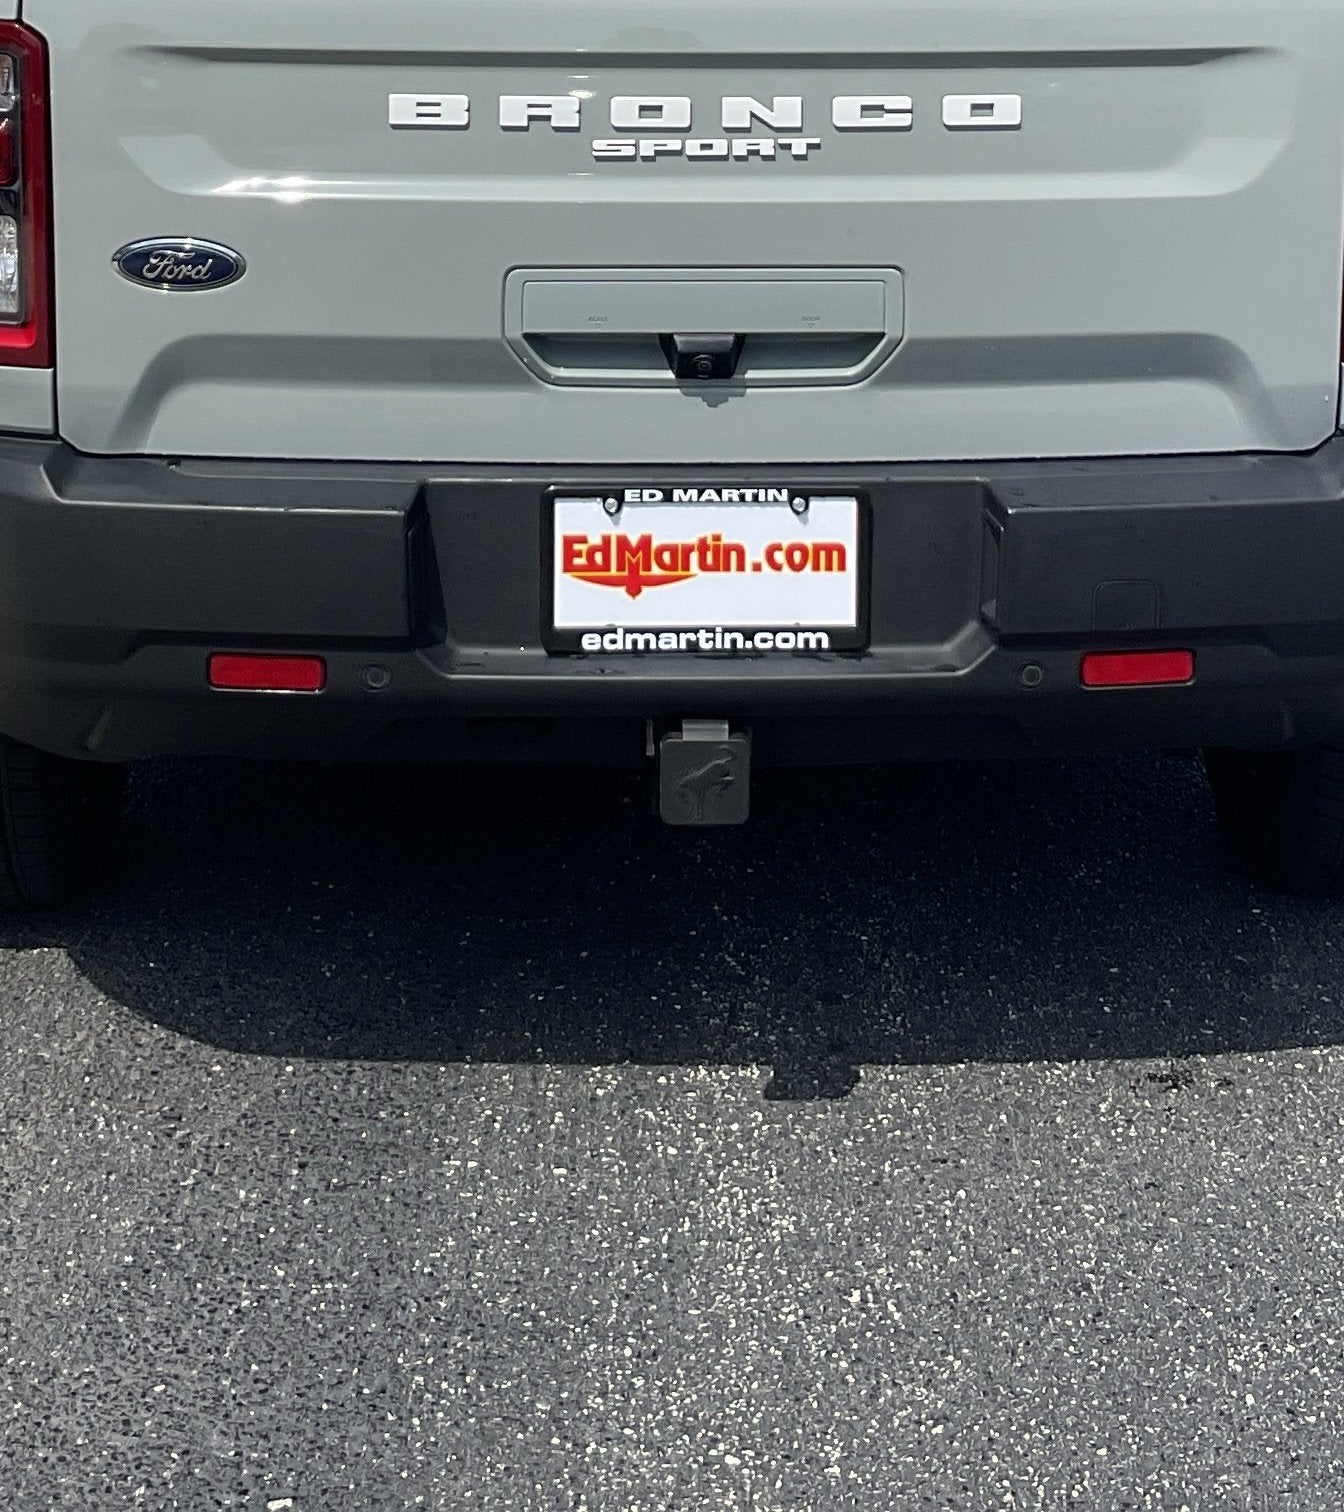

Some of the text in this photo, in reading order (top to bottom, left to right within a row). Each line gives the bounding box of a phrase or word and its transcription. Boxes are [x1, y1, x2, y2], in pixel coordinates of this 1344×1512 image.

[389, 93, 1022, 129] BRONCO
[591, 137, 821, 161] SPORT
[142, 250, 213, 279] Ford
[624, 489, 789, 502] ED MARTIN
[562, 534, 847, 582] EdMartin.com
[581, 627, 829, 650] edmartin.com
